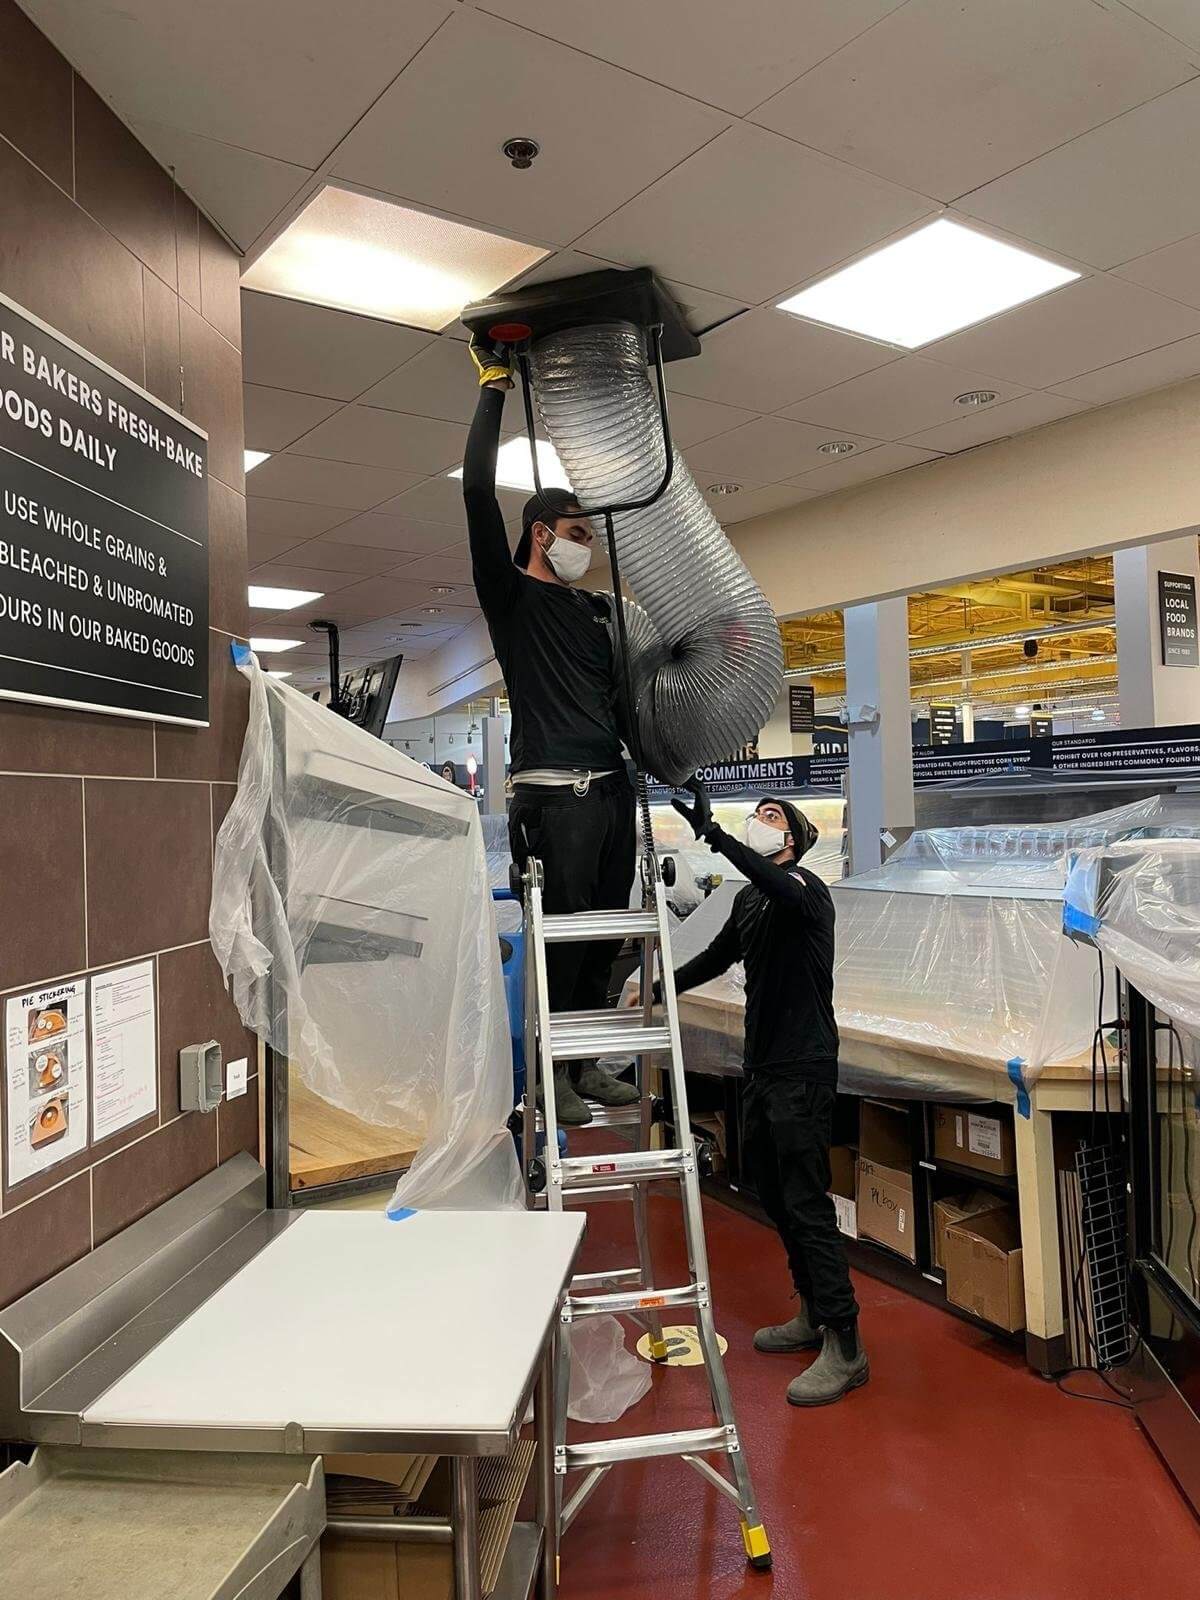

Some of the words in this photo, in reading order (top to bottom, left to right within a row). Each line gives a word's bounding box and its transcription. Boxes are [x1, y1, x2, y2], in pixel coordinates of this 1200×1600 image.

[22, 343, 104, 417] BAKERS
[107, 397, 203, 478] FRESH-BAKE
[0, 388, 53, 438] ODS
[59, 418, 118, 472] DAILY
[4, 489, 39, 526] USE
[43, 506, 101, 551] WHOLE
[105, 534, 156, 573] GRAINS
[158, 556, 168, 578] &
[1164, 580, 1191, 590] SUPPORTING
[93, 574, 103, 598] &
[107, 579, 194, 628] UNBROMATED
[1165, 598, 1190, 610] LOCAL
[1166, 612, 1187, 624] FOOD
[47, 607, 64, 633] IN
[69, 614, 101, 643] OUR
[105, 624, 150, 655] BAKED
[152, 638, 195, 667] GOODS
[1166, 627, 1195, 639] BRANDS
[1063, 738, 1097, 746] STANDARDS
[1052, 753, 1081, 761] PROHIBIT
[1081, 751, 1099, 760] OVER
[1099, 751, 1112, 759] 100
[1112, 748, 1167, 758] PRESERVATIVES,
[953, 758, 995, 767] HIGH-FRUCTOSE
[1012, 756, 1031, 764] SYRUP
[1058, 762, 1079, 770] OTHER
[1079, 760, 1124, 769] INGREDIENTS
[1123, 758, 1165, 767] COMMONLY
[1165, 756, 1191, 764] FOUND
[1191, 755, 1200, 763] IN
[694, 761, 794, 781] COMMITMENTS
[933, 768, 967, 777] SWEETENERS
[974, 767, 986, 775] ANY
[986, 766, 1002, 774] FOOD
[711, 783, 744, 793] STANDARD
[780, 780, 796, 790] ELSE
[22, 995, 35, 1009] PIE
[39, 984, 77, 1003] STICKERING
